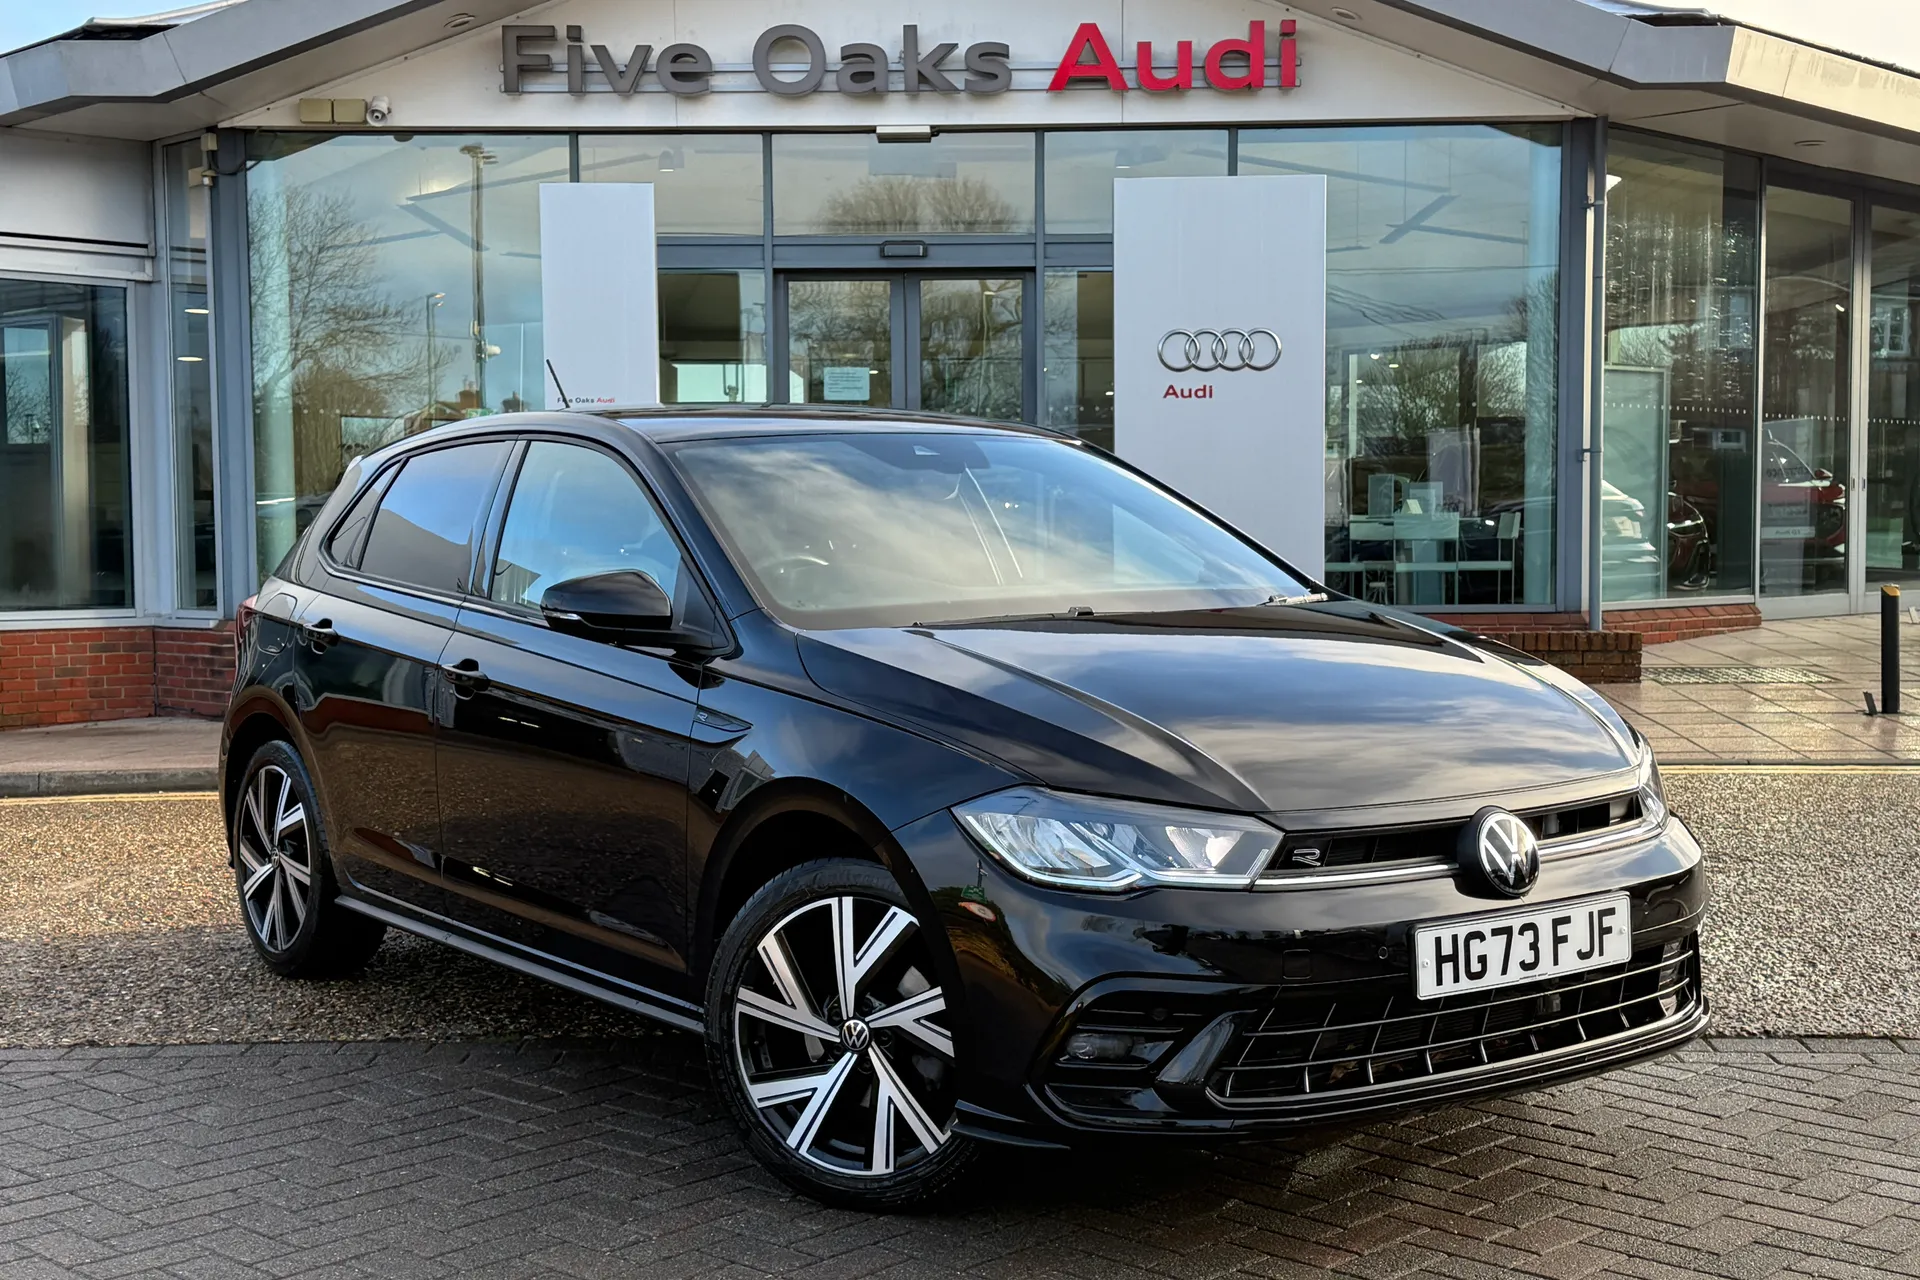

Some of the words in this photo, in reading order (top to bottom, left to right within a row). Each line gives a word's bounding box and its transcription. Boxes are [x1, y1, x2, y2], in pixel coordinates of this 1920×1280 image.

[502, 24, 714, 97] Five
[752, 23, 1012, 97] Oaks
[1047, 19, 1297, 93] Audi
[575, 396, 595, 404] Oaks
[596, 396, 616, 404] Audi
[1163, 384, 1213, 399] Audi
[1434, 921, 1541, 987] HG73
[1551, 907, 1616, 967] FJF
